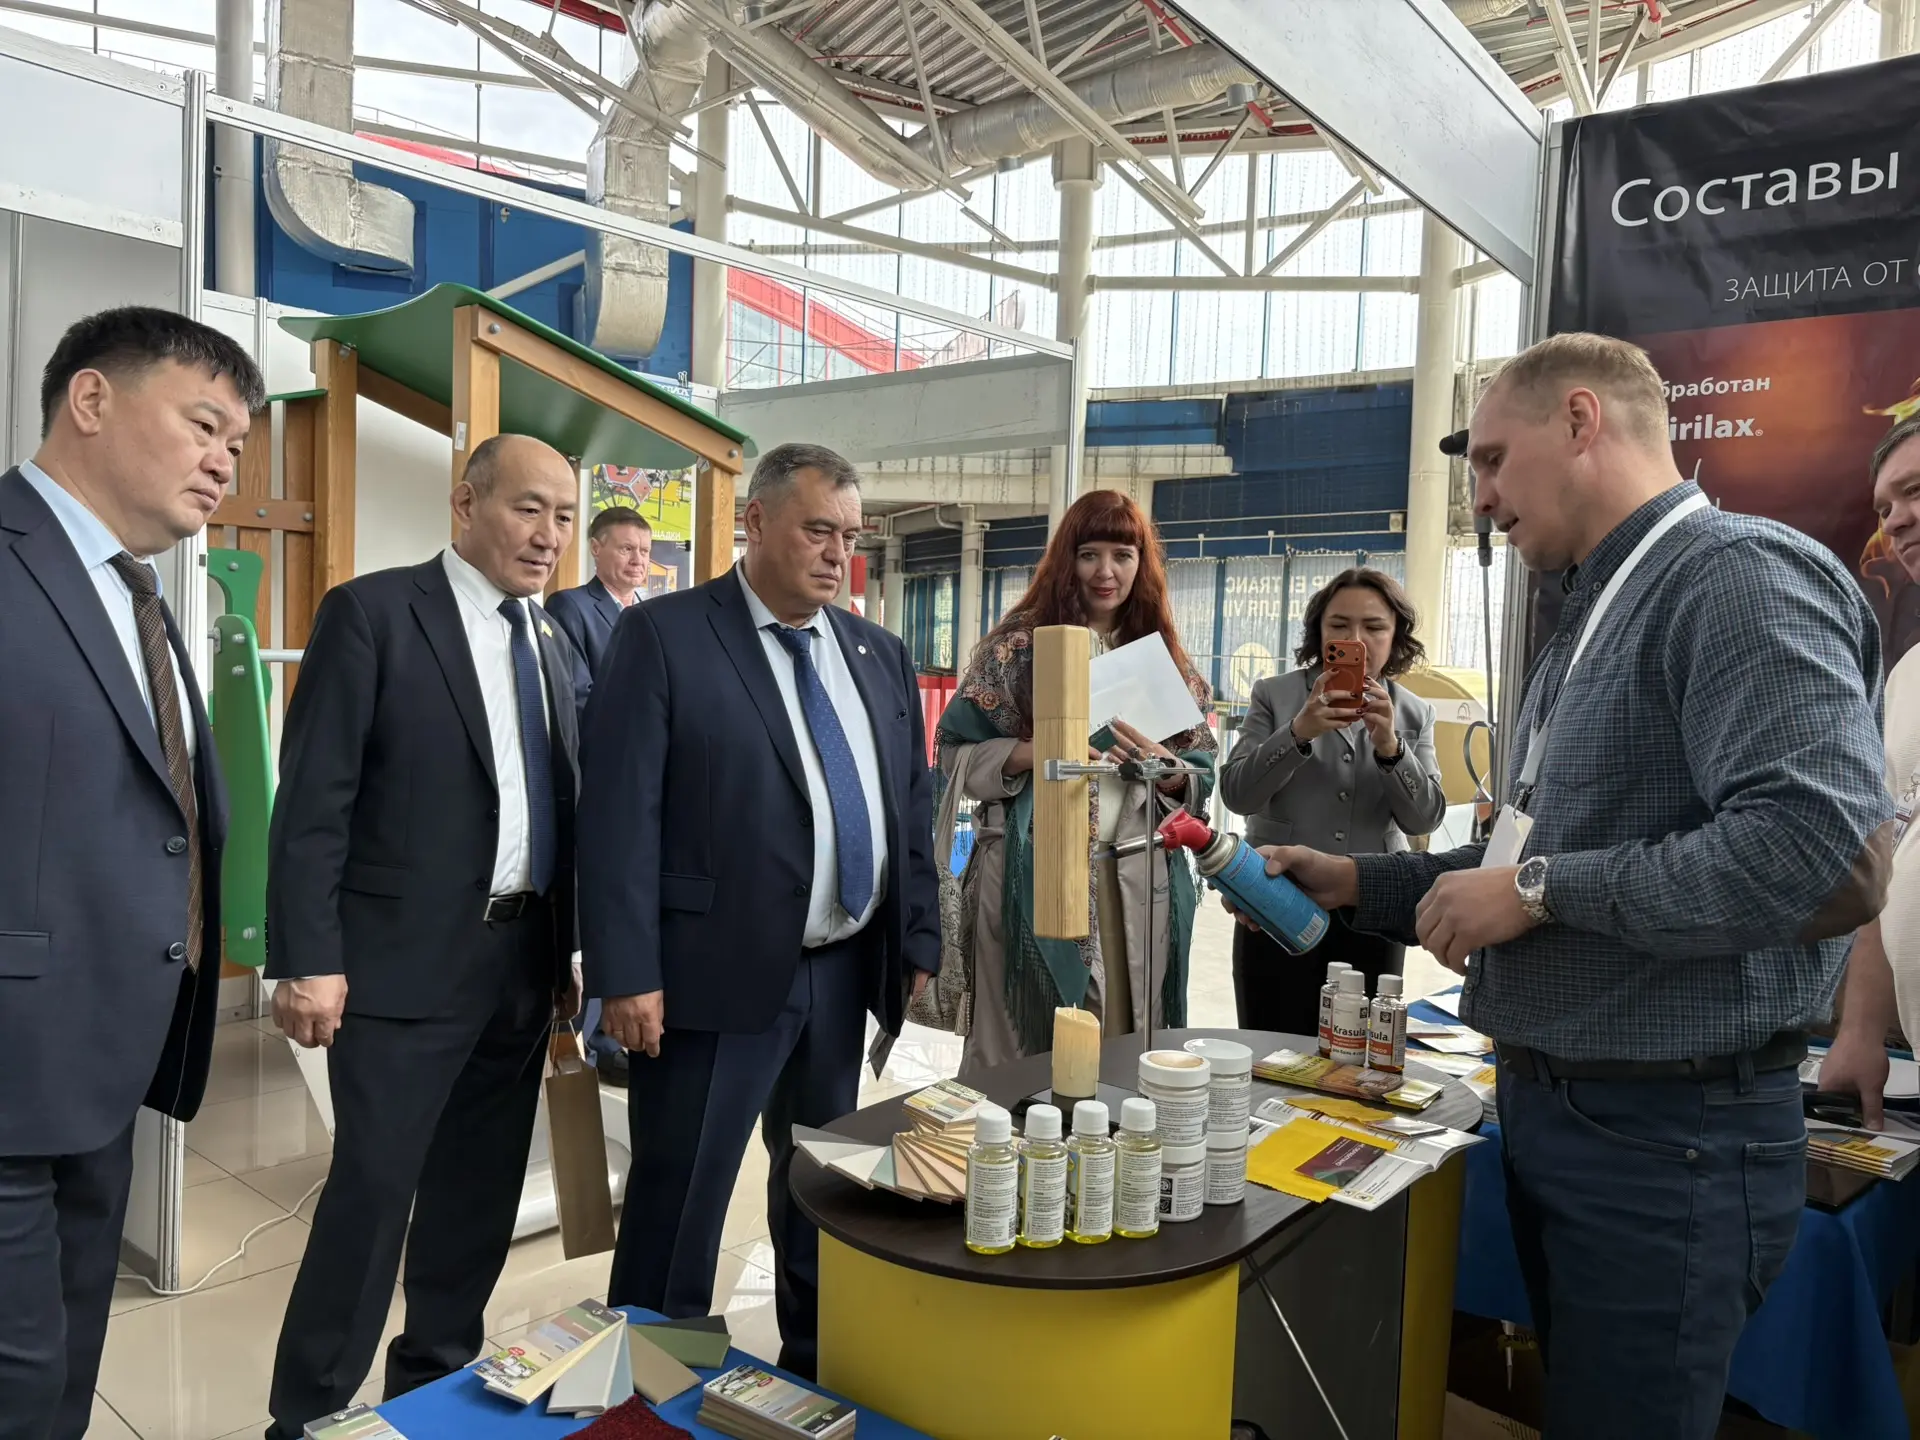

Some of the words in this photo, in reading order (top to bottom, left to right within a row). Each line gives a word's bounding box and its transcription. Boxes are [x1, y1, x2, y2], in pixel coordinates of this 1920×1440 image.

[1611, 152, 1899, 227] Составы
[1724, 265, 1852, 302] ЗАЩИТА
[1863, 258, 1909, 286] ОТ
[1662, 376, 1771, 403] бработан
[1669, 413, 1755, 441] irilax
[1333, 1024, 1366, 1037] Krasula
[1370, 1031, 1388, 1041] sula
